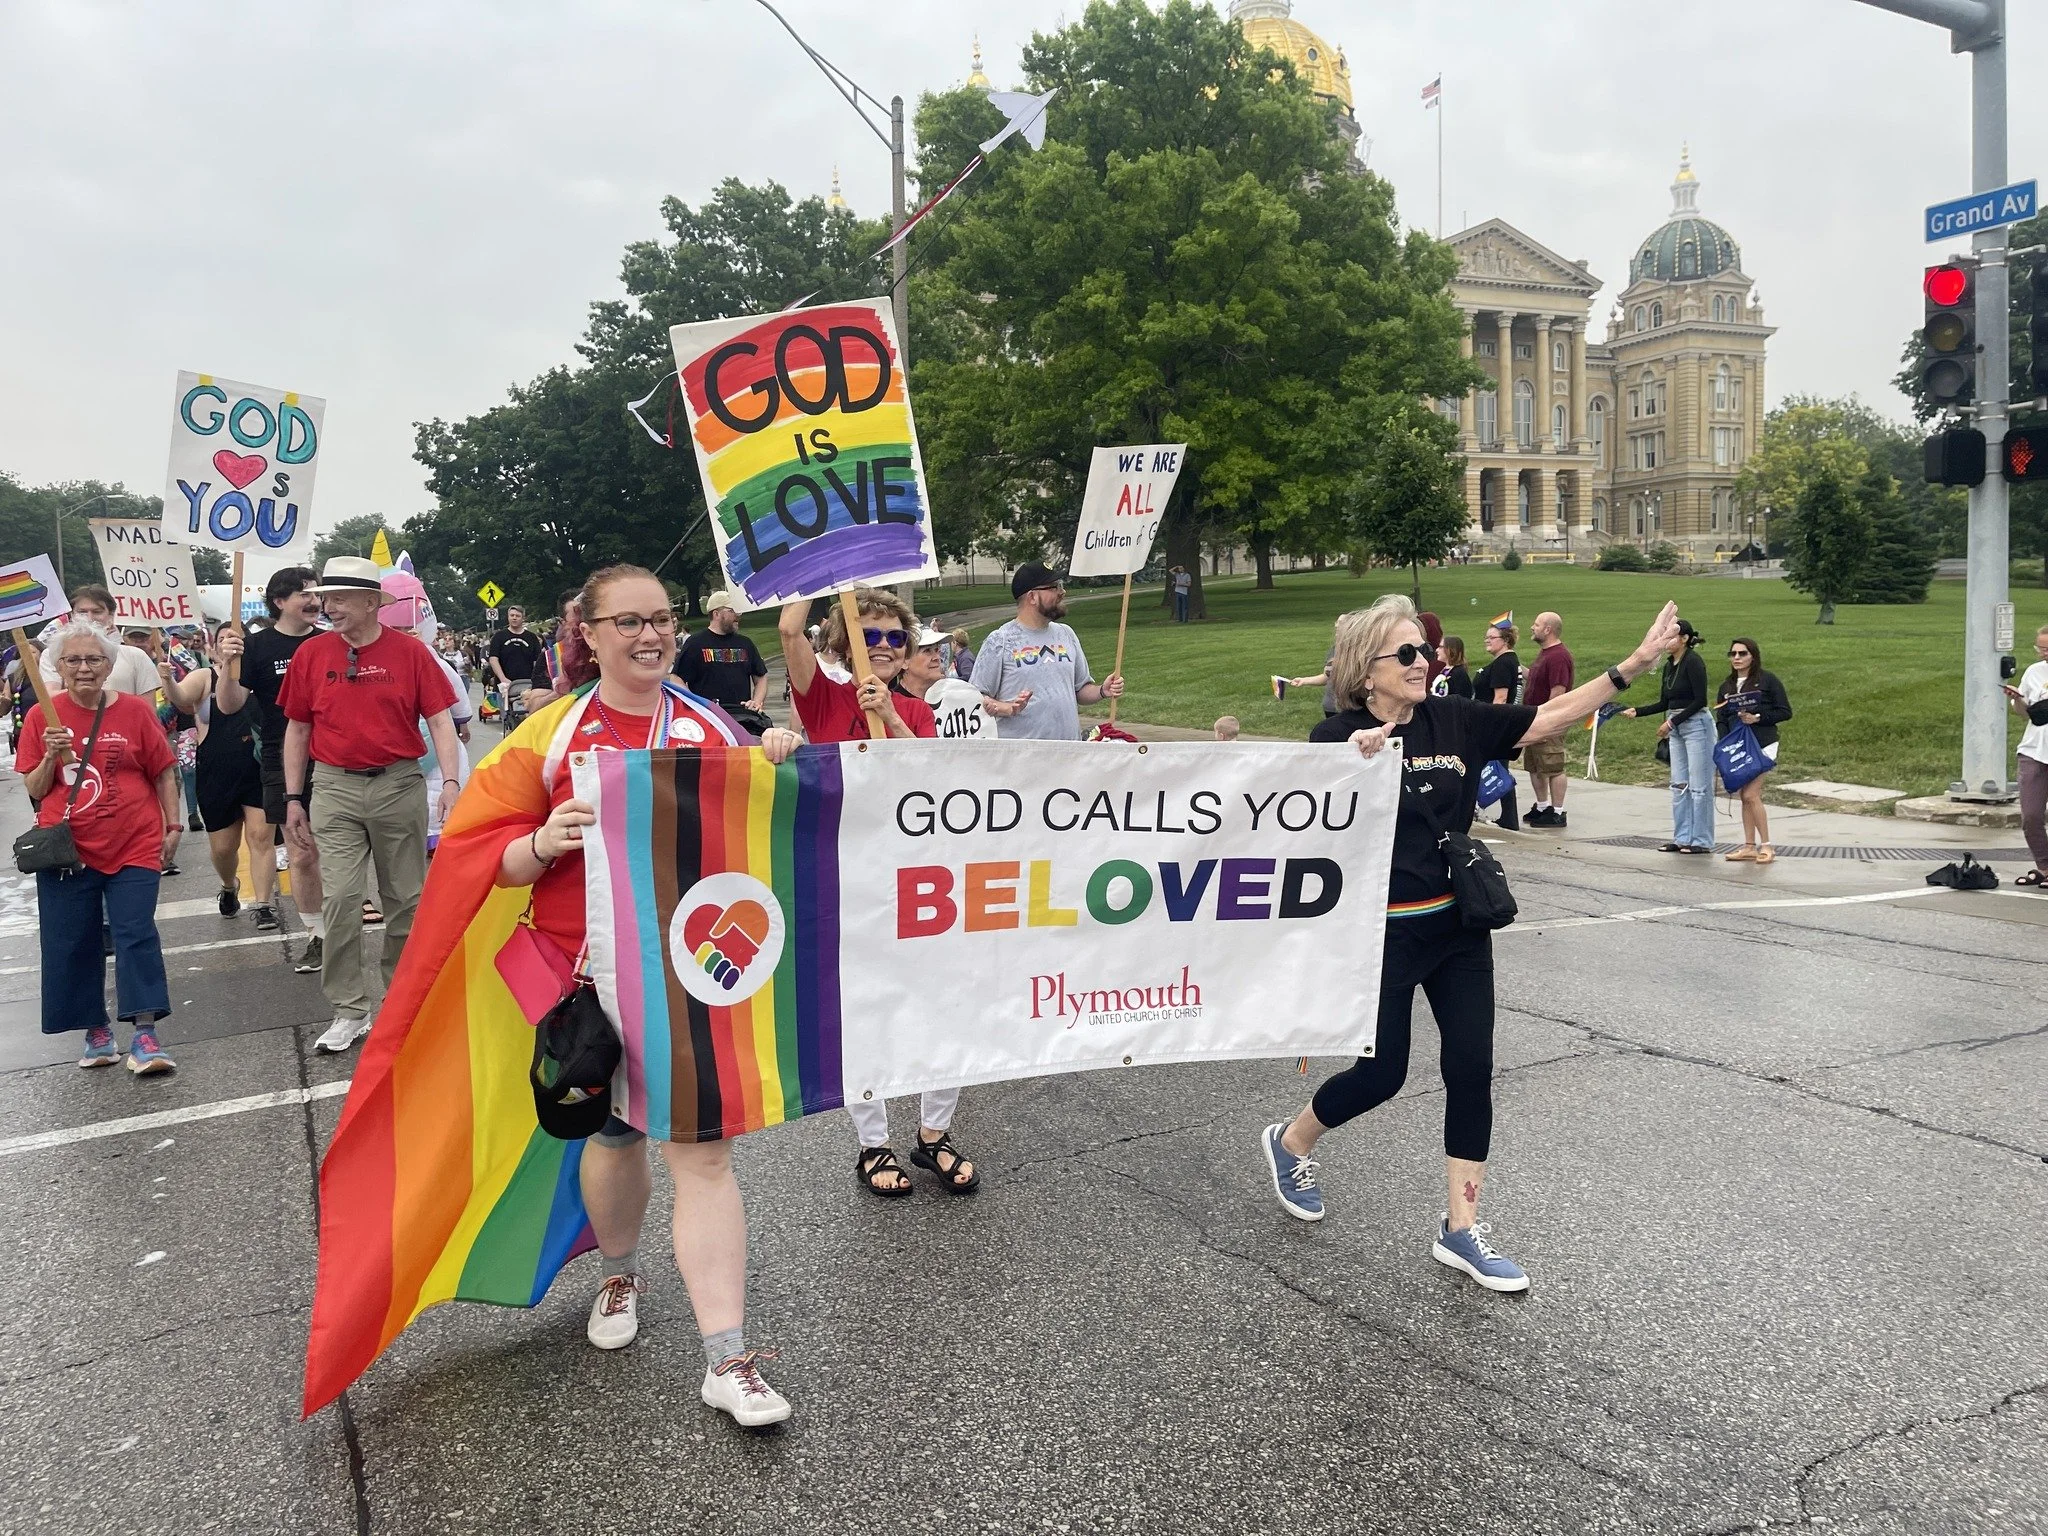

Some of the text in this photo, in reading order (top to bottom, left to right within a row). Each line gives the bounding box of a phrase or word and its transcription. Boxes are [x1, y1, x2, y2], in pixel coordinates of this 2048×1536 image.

[1931, 194, 2029, 233] Grand Av
[705, 325, 891, 434] GOD
[181, 385, 317, 464] GOD
[794, 428, 839, 466] IS
[1119, 452, 1178, 473] WE ARE
[176, 479, 298, 548] YOU
[734, 457, 917, 573] LOVE
[1116, 483, 1154, 516] ALL
[106, 526, 178, 545] MAD
[1085, 530, 1132, 550] Children
[111, 567, 179, 589] GOD'S
[115, 595, 194, 620] IMAGE
[338, 669, 395, 684] Pmouth
[1412, 755, 1466, 777] BELOVED
[896, 788, 1359, 837] GOD CALLS YOU
[897, 858, 1343, 940] BELOVED
[1030, 965, 1203, 1029] Plymouth
[1088, 1007, 1203, 1026] UNITED CHURCH OF CHRIST
